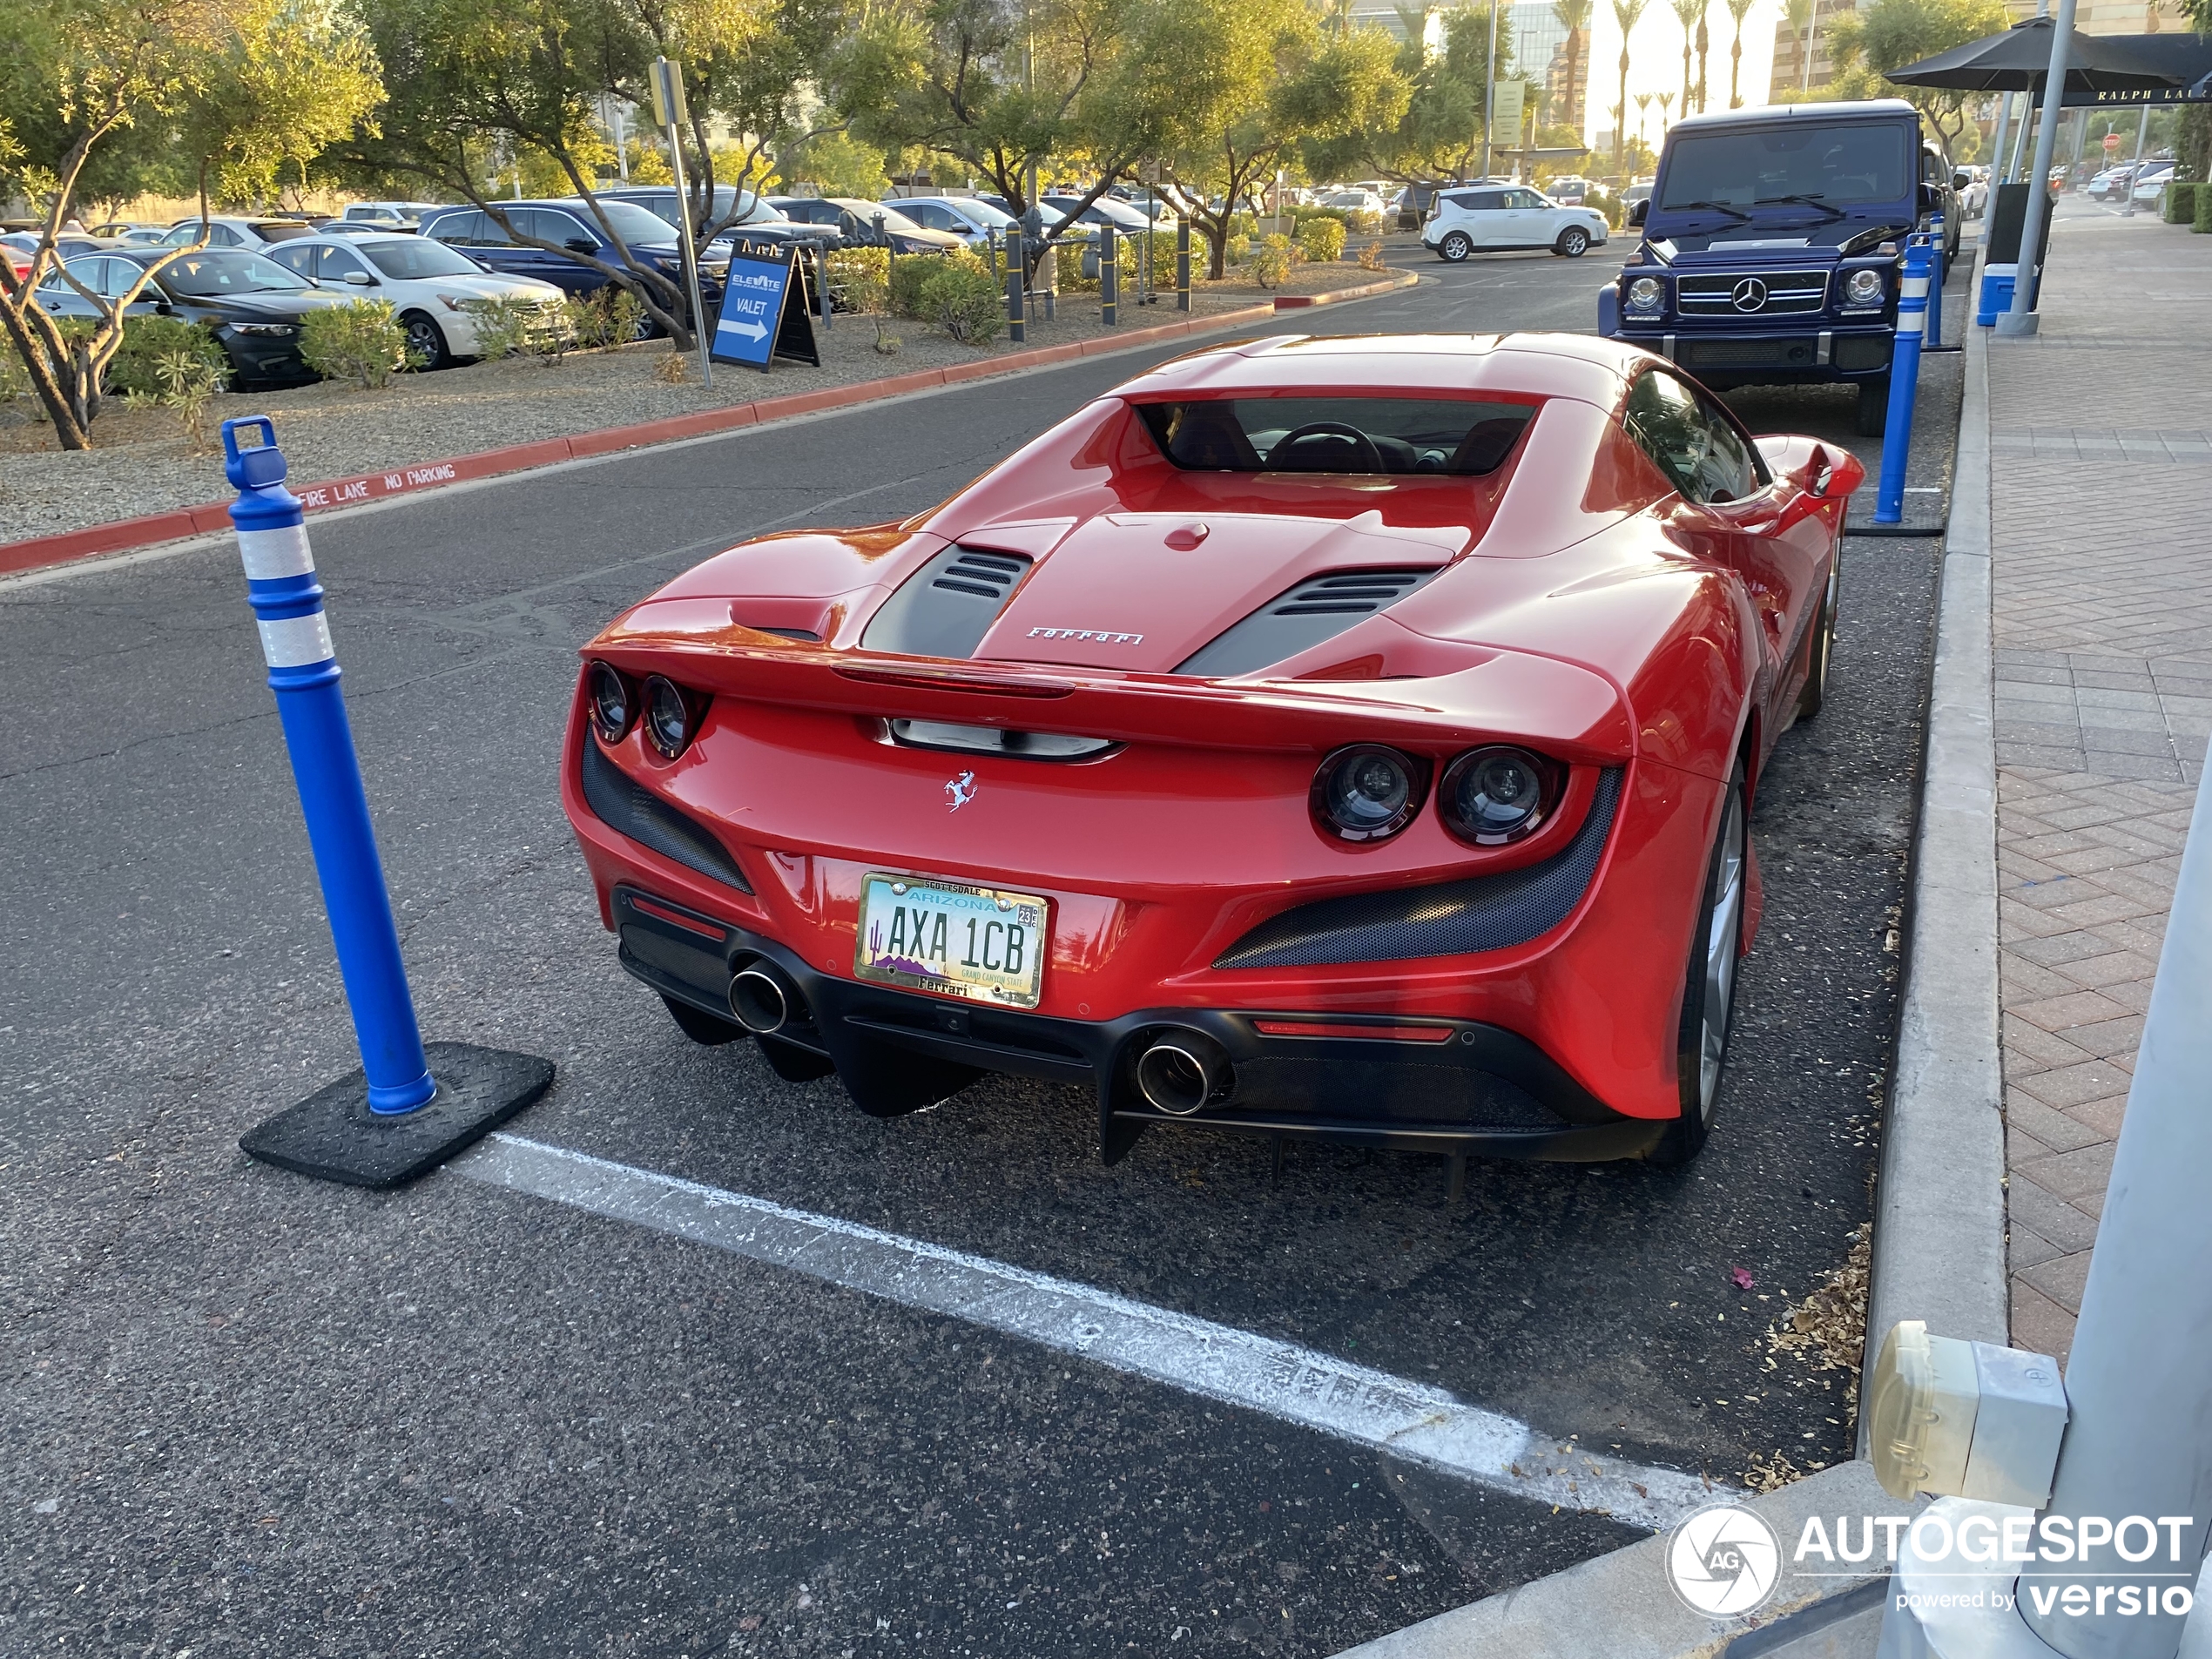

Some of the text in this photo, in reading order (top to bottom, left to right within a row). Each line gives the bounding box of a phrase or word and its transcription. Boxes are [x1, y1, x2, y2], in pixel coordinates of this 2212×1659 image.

[2098, 90, 2152, 101] RALPH
[732, 274, 781, 289] ELEVATE
[737, 297, 767, 316] VALET
[298, 463, 455, 508] FIRE LANE NO PARKING
[1026, 627, 1144, 646] Ferrari
[924, 880, 981, 896] SCOTTSDALE
[908, 892, 998, 913] ARIZONA
[1018, 910, 1031, 923] 23
[887, 906, 1025, 974] AXA 1CB
[918, 976, 968, 997] Ferrari
[961, 969, 1023, 988] GRAND CANYON STATE
